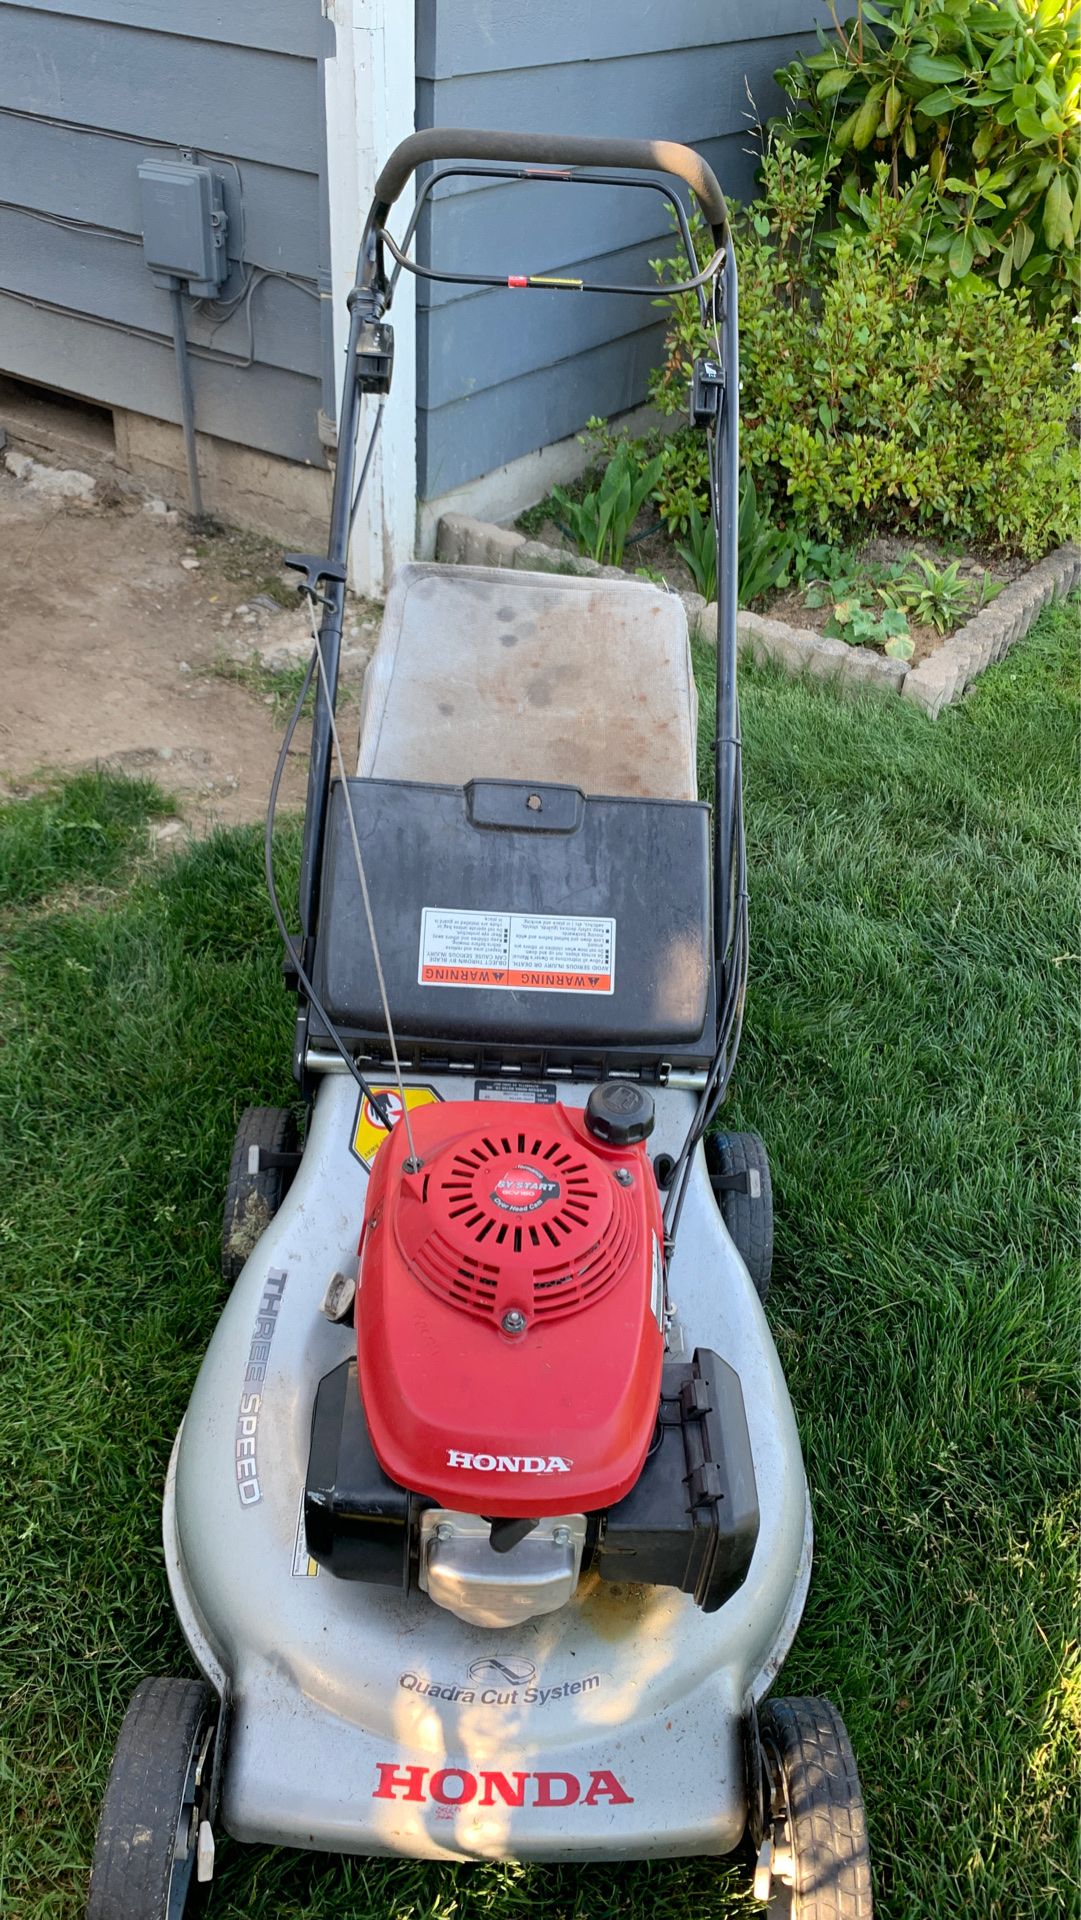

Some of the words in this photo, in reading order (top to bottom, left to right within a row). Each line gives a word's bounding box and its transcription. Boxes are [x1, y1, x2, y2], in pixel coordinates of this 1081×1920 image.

[425, 969, 489, 981] WARNING
[521, 974, 585, 986] WARNING
[245, 1273, 287, 1382] THREE
[236, 1394, 261, 1505] SPEED
[446, 1450, 570, 1473] HONDA
[400, 1673, 474, 1703] Quadra
[481, 1689, 518, 1705] Cut
[524, 1675, 599, 1706] System
[372, 1762, 634, 1807] HONDA
